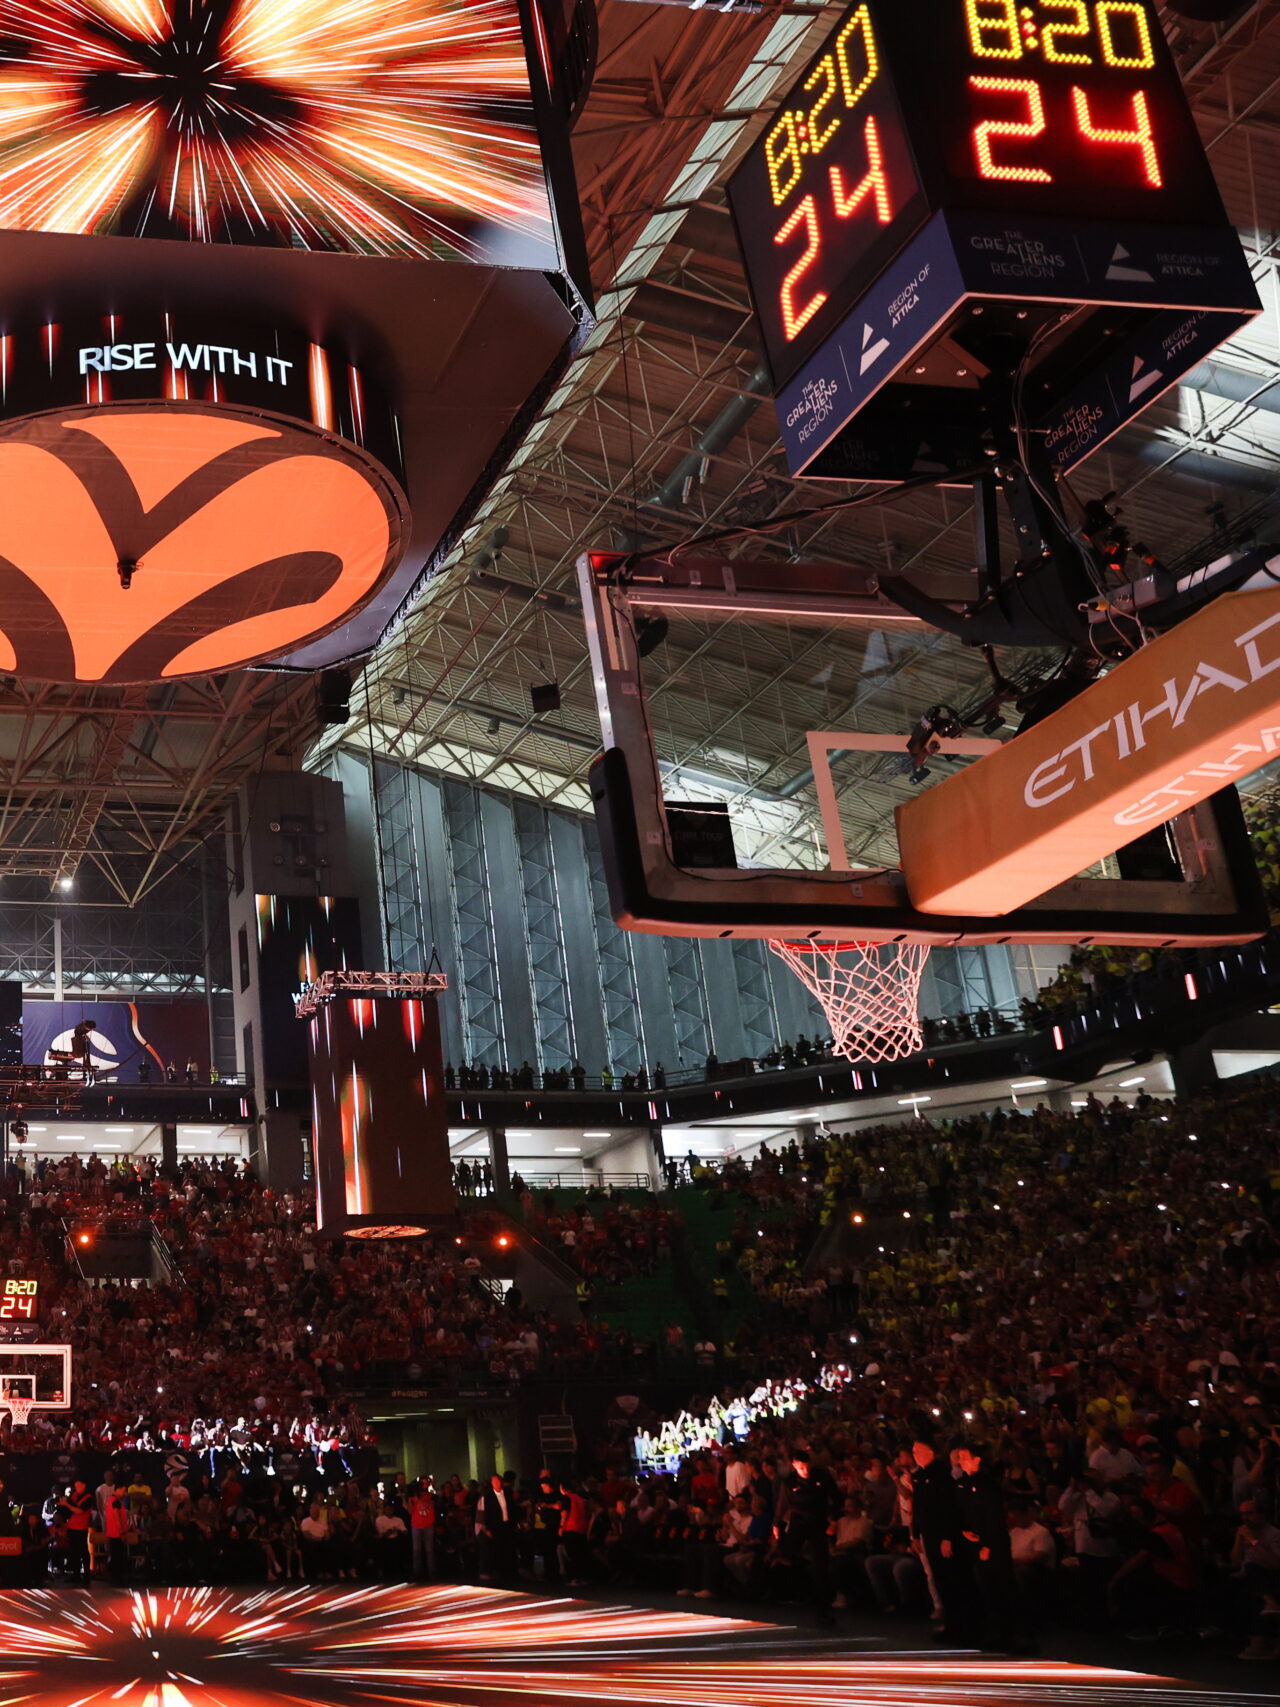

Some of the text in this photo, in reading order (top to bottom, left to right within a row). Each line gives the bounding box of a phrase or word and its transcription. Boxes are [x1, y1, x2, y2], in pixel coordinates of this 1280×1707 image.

[965, 0, 1155, 68] 8:20
[766, 4, 878, 206] 8:20
[968, 75, 1163, 188] 24
[774, 115, 892, 342] 24
[887, 264, 931, 317] REGION OF
[991, 261, 1055, 279] REGION
[1161, 265, 1205, 277] ATTICA
[892, 294, 920, 328] ATTICA
[78, 342, 293, 386] RISE WITH IT
[1166, 330, 1198, 361] ATTICA
[798, 399, 834, 445] REGION
[1057, 425, 1098, 464] REGION
[0, 1297, 33, 1319] 24
[5, 1280, 38, 1295] 8:20
